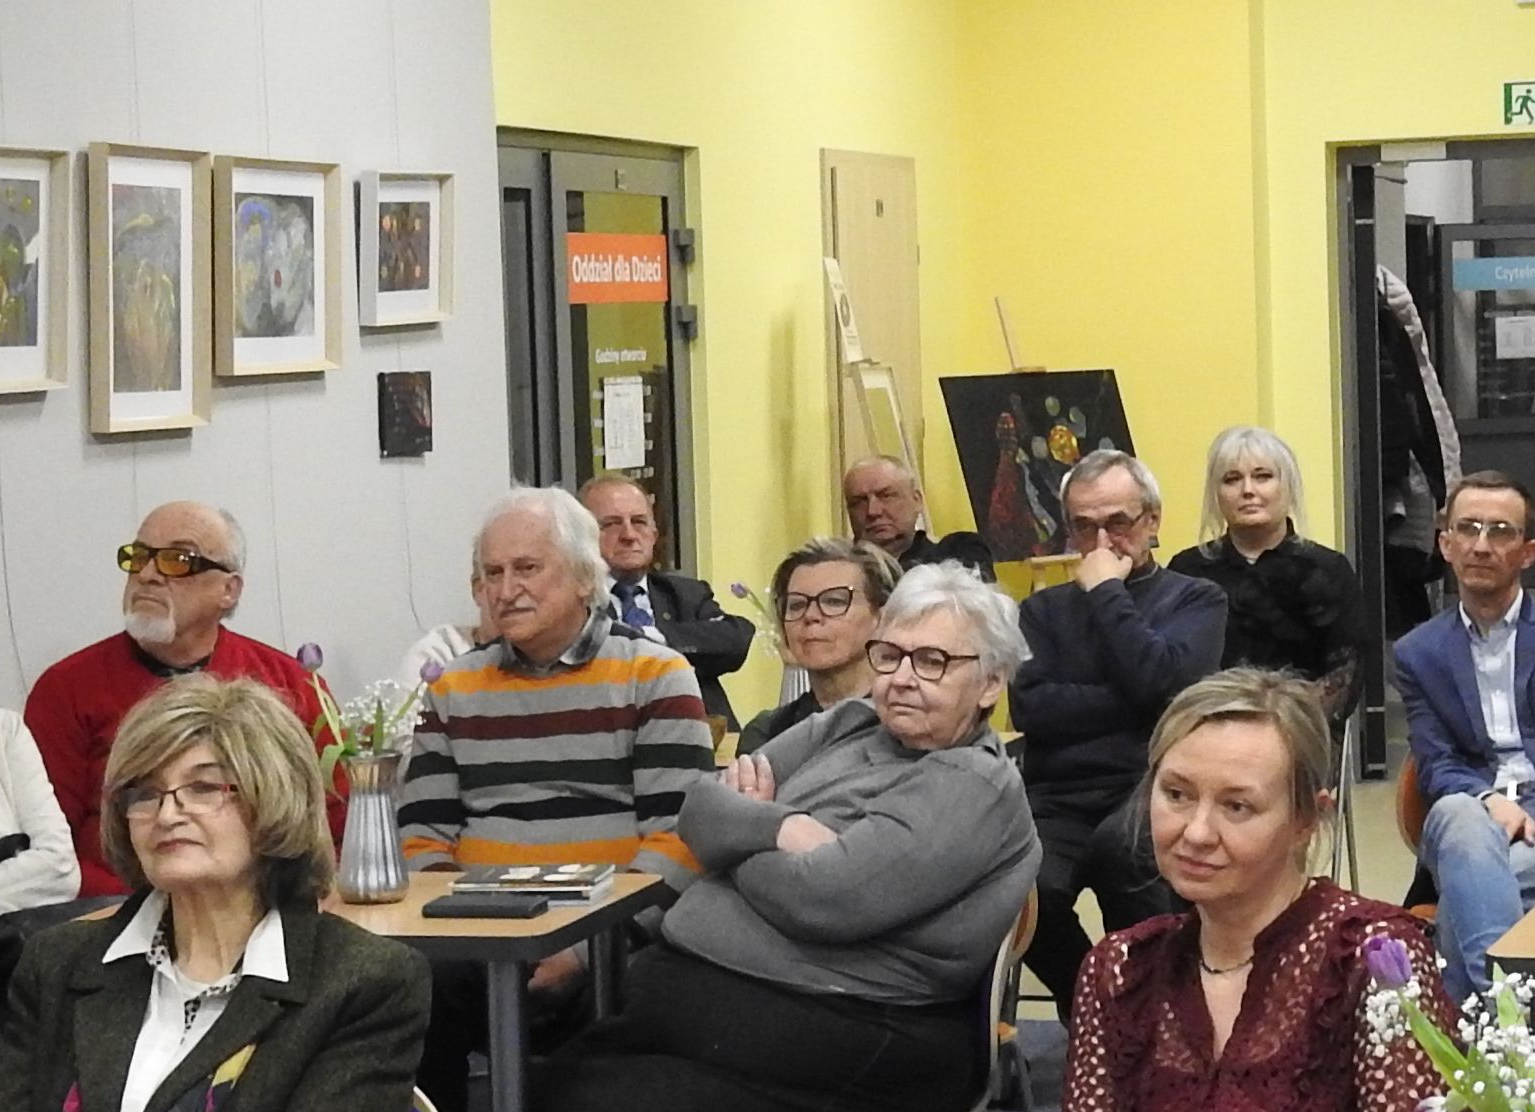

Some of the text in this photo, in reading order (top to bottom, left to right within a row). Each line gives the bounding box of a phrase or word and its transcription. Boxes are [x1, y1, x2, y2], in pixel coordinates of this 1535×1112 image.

[571, 253, 661, 283] Oddział dla Dzieci
